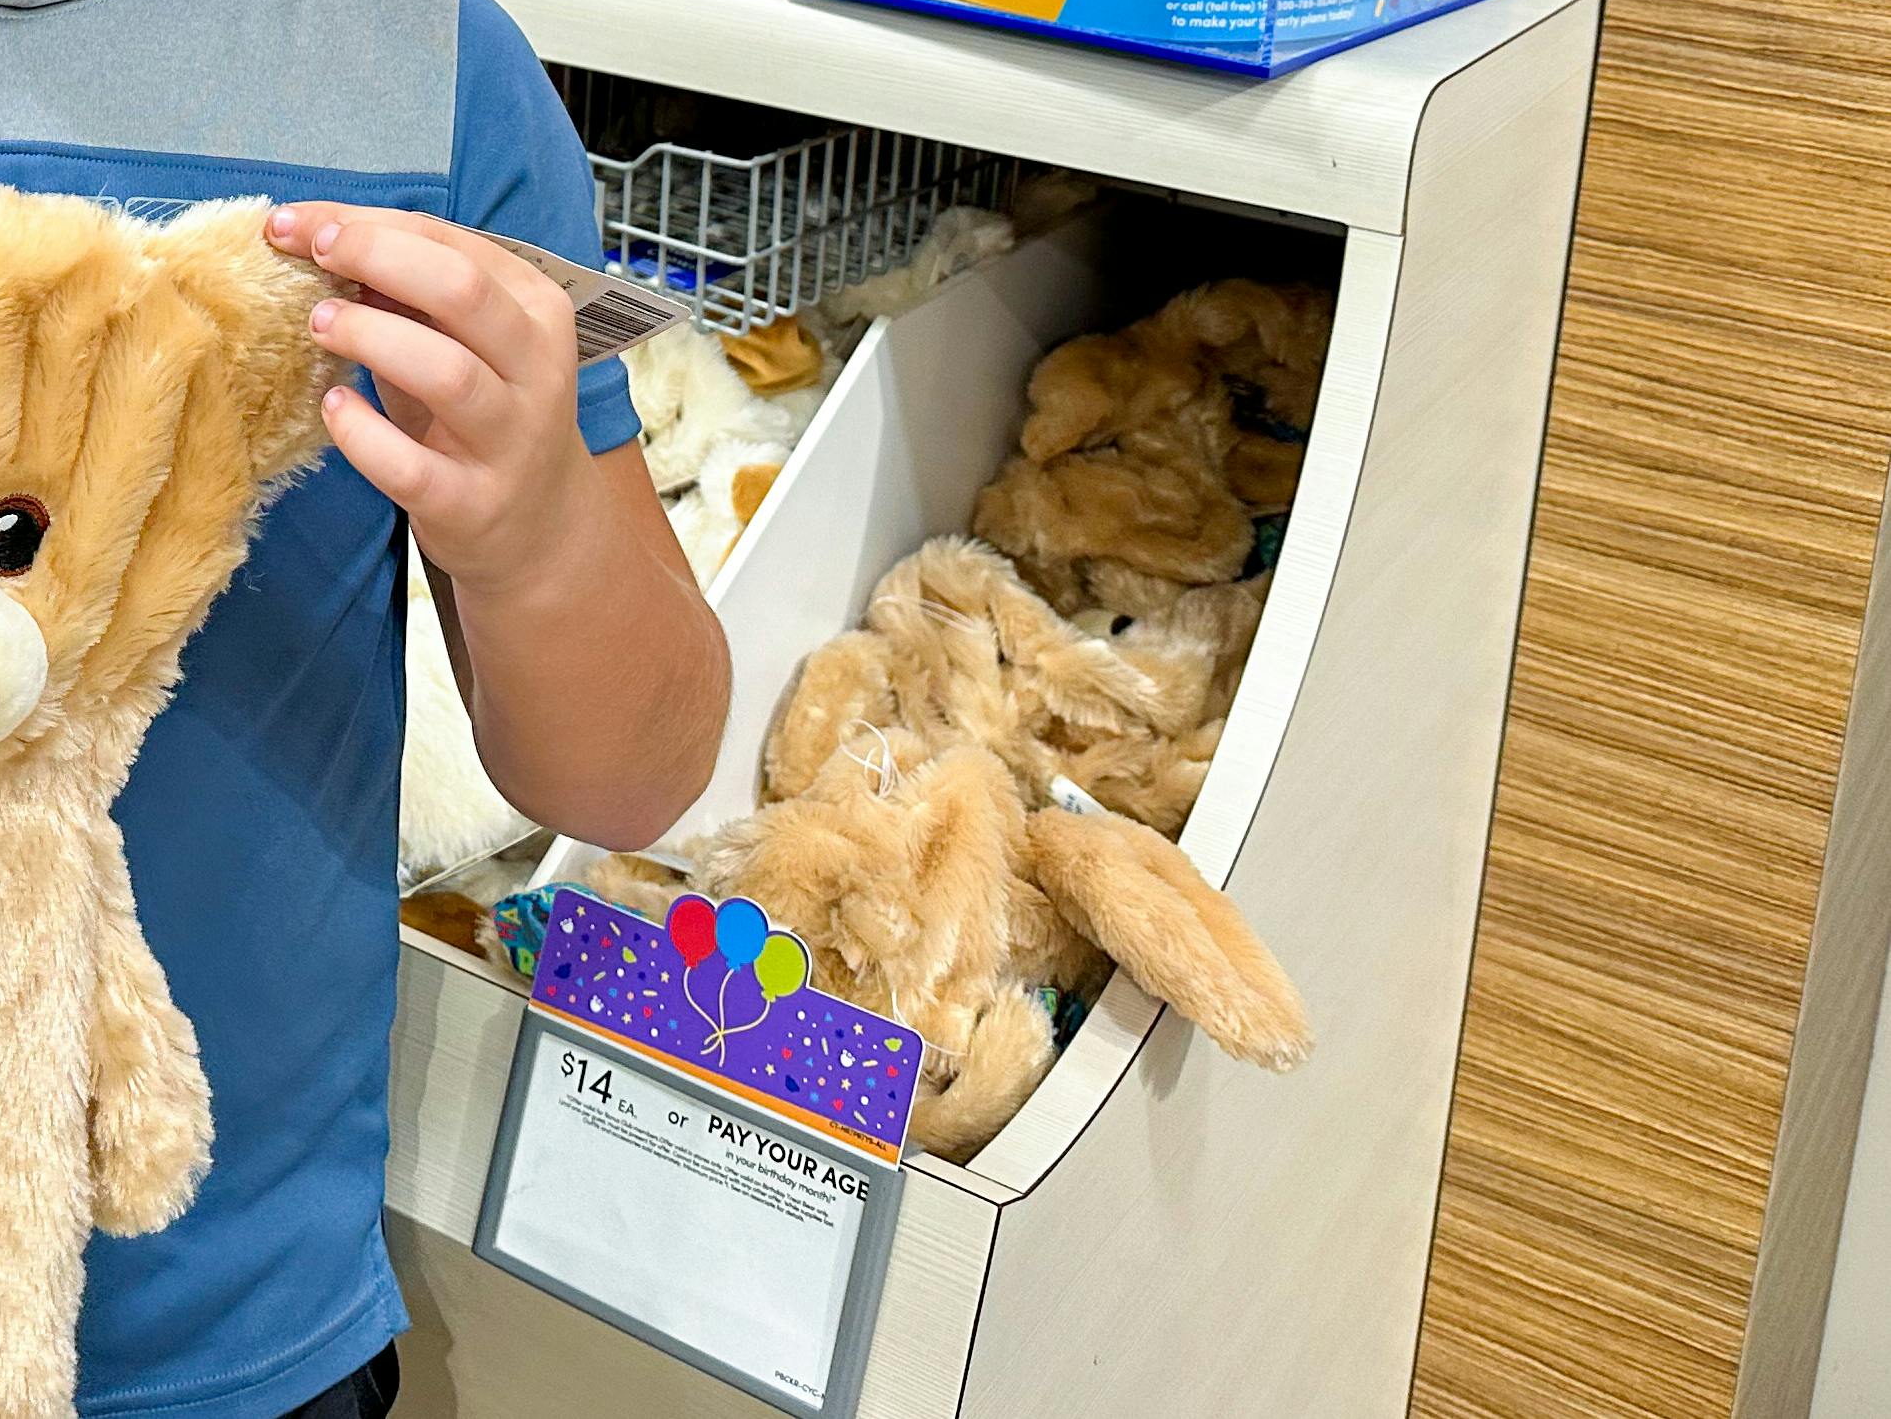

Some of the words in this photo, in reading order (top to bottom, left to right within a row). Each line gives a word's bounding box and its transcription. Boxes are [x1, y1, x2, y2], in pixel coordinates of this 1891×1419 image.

[1166, 2, 1180, 10] or
[1181, 1, 1203, 11] call
[1206, 1, 1229, 13] (toll
[1230, 1, 1255, 13] free)
[1172, 16, 1186, 26] to
[1189, 17, 1226, 27] make
[1229, 18, 1258, 30] your
[560, 1050, 612, 1105] $14
[668, 1111, 689, 1129] or
[708, 1114, 752, 1149] PAY
[756, 1134, 818, 1179] YOUR
[821, 1167, 869, 1202] AGE
[726, 1148, 733, 1159] in
[735, 1154, 755, 1169] your
[759, 1161, 798, 1190] birthday
